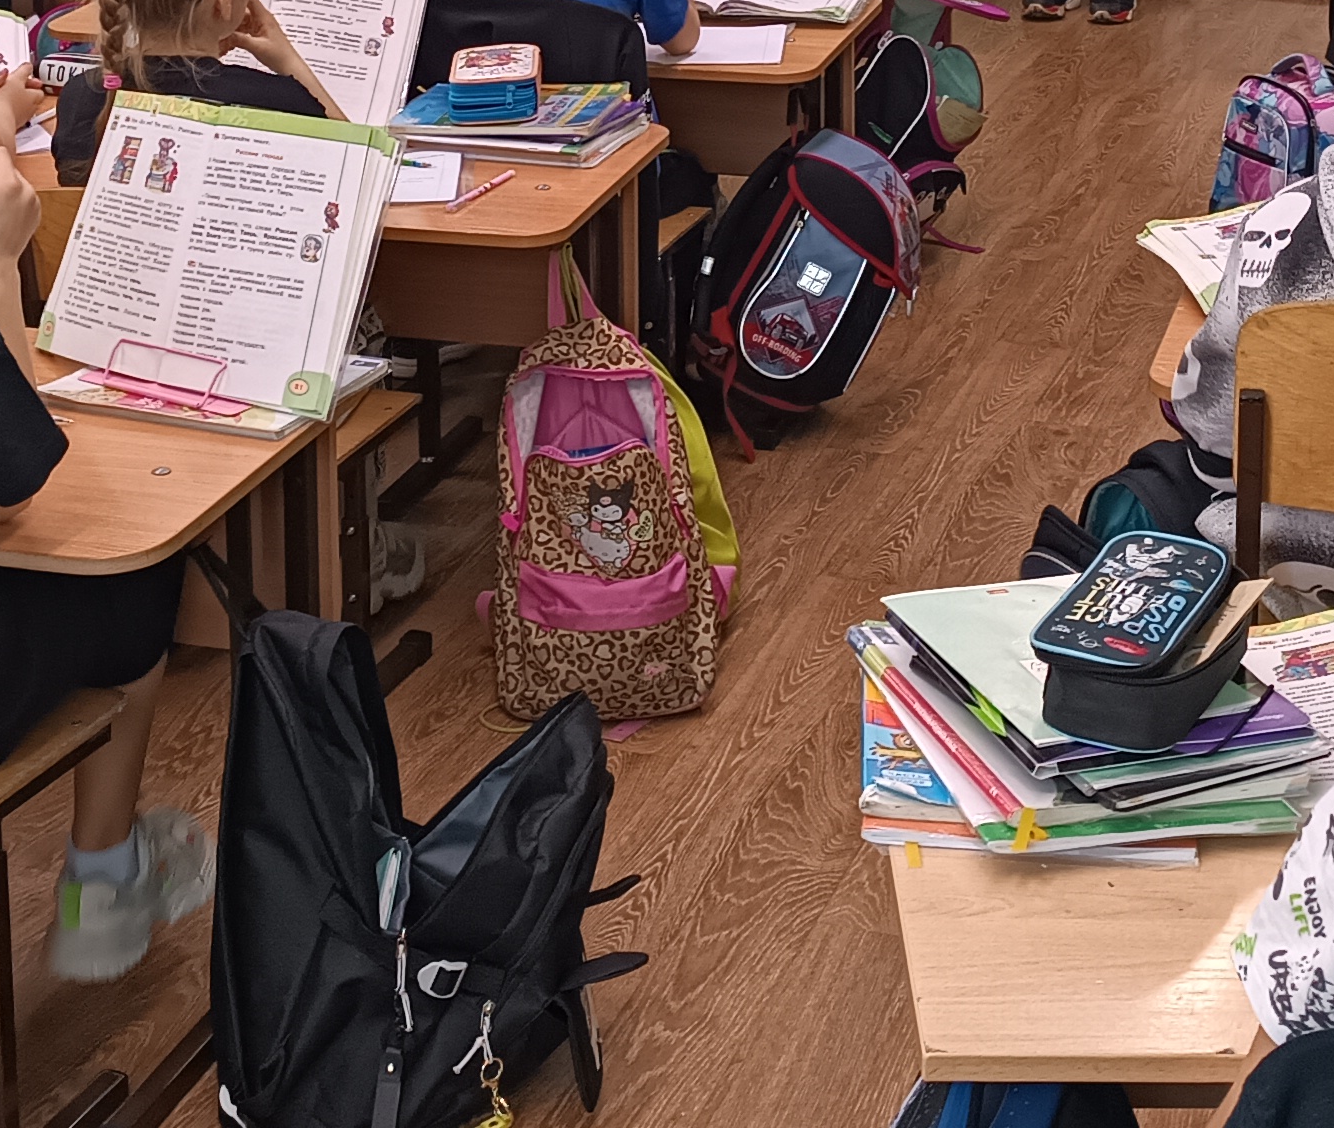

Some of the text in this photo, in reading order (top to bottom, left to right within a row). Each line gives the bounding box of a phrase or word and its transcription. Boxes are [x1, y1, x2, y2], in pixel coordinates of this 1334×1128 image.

[751, 333, 803, 363] OFF-ROADING
[1289, 893, 1310, 937] LIFE
[1303, 876, 1327, 938] ENJOY
